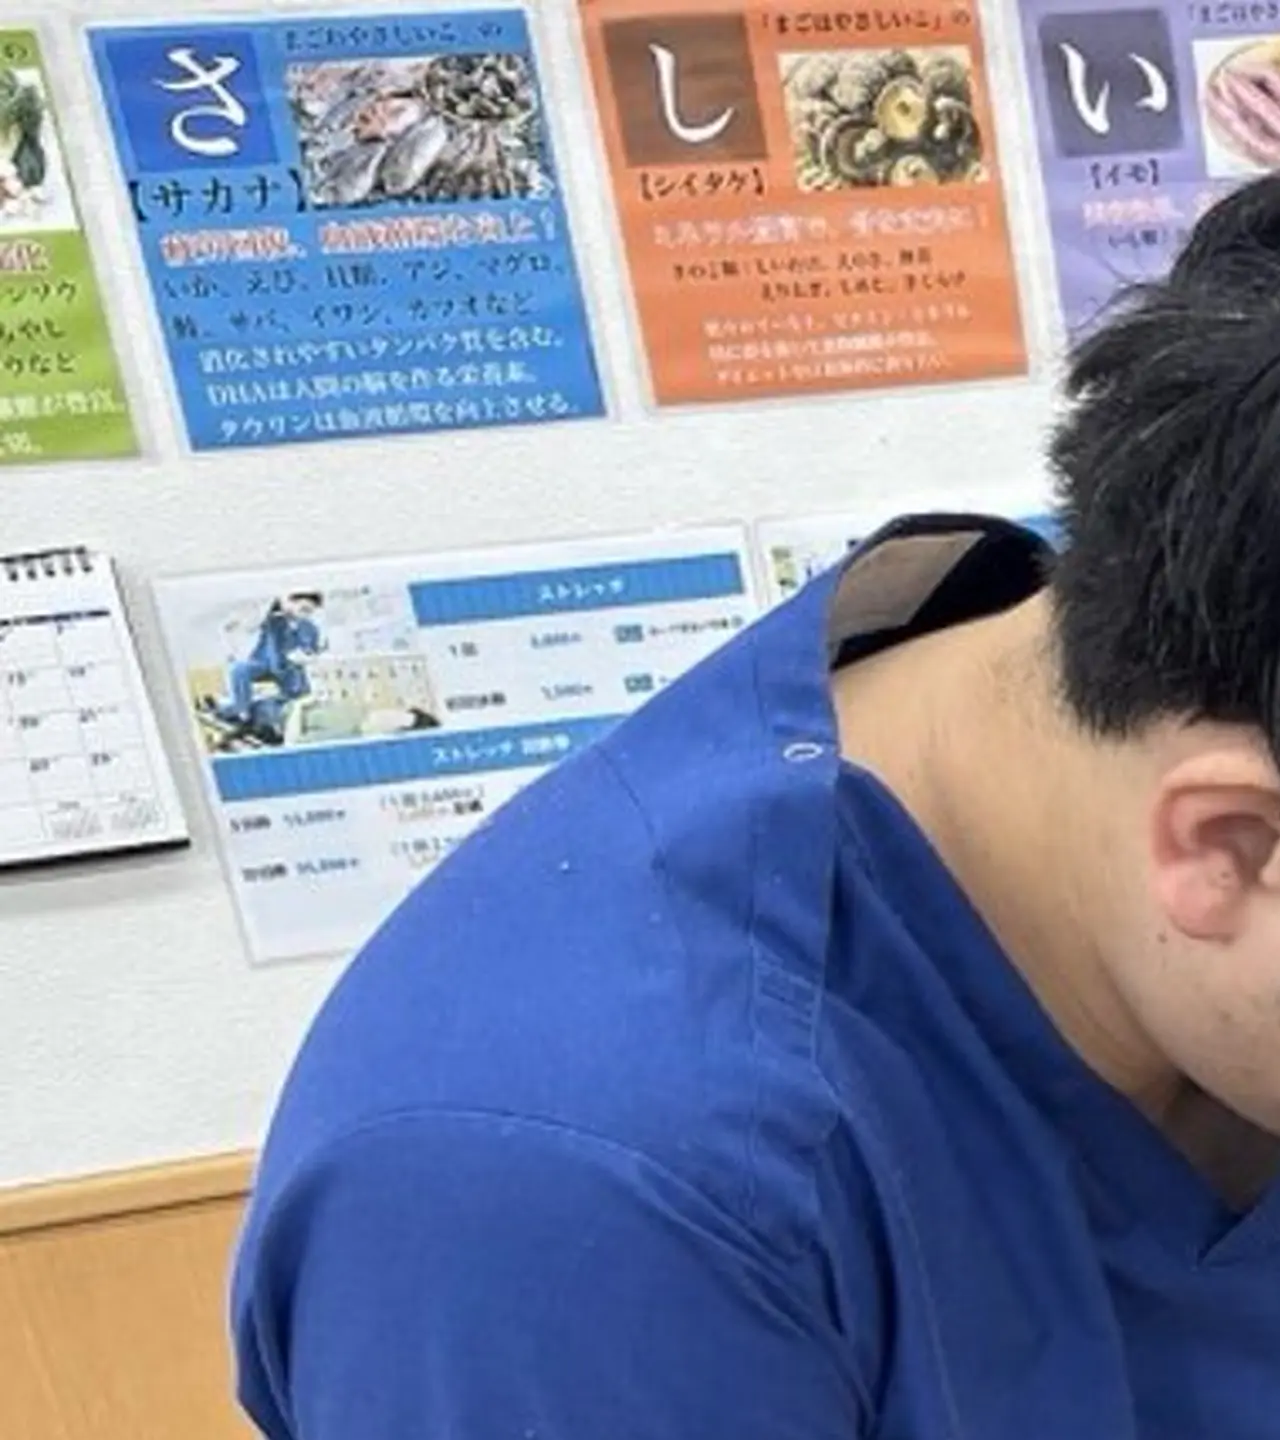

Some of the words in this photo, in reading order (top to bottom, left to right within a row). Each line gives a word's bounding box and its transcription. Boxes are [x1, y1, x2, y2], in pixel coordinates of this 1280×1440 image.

[153, 47, 248, 155] さ
[649, 43, 736, 142] し
[1060, 42, 1168, 134] い
[129, 168, 306, 222] 【サカナ】
[641, 166, 764, 201] 【シイタケ】
[1090, 157, 1159, 190] 【イモ】
